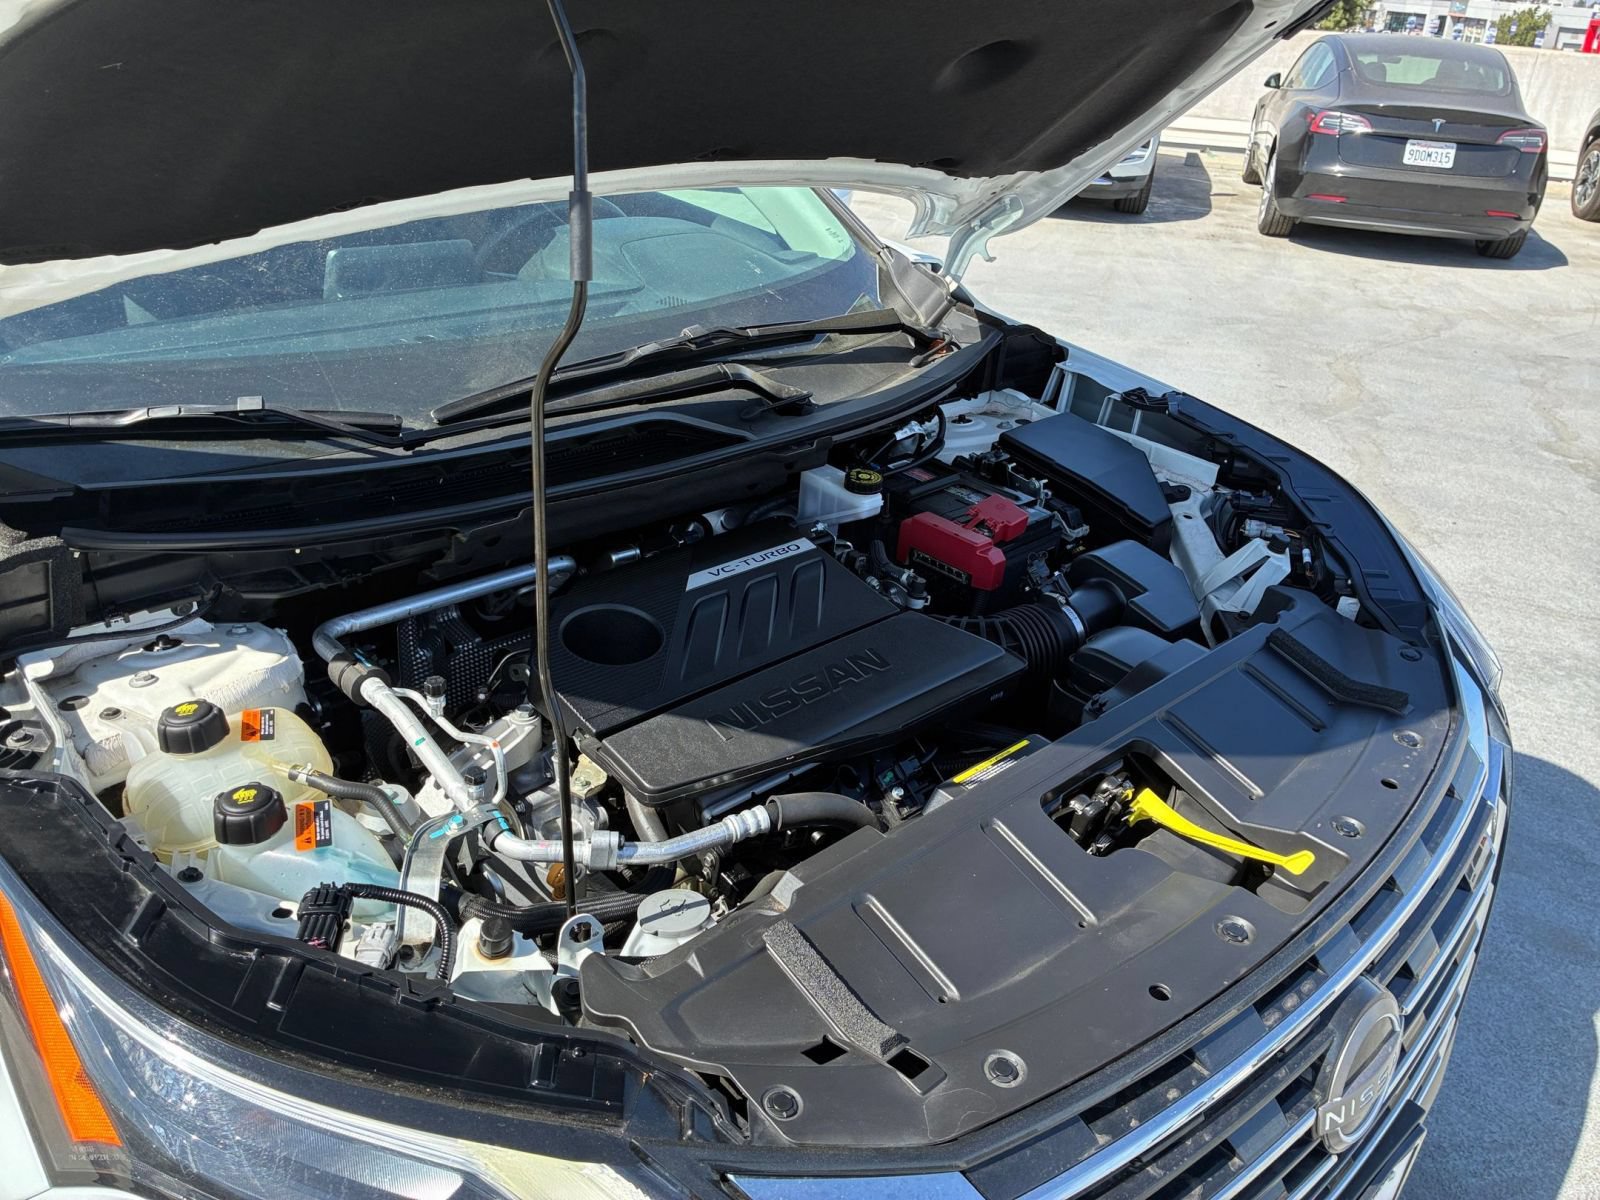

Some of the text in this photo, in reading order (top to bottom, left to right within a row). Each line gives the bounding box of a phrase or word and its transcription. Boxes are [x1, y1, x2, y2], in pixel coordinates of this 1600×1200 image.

[707, 543, 801, 577] VC-TURBO
[704, 648, 893, 742] NISSAN
[1324, 1051, 1398, 1131] NISS
